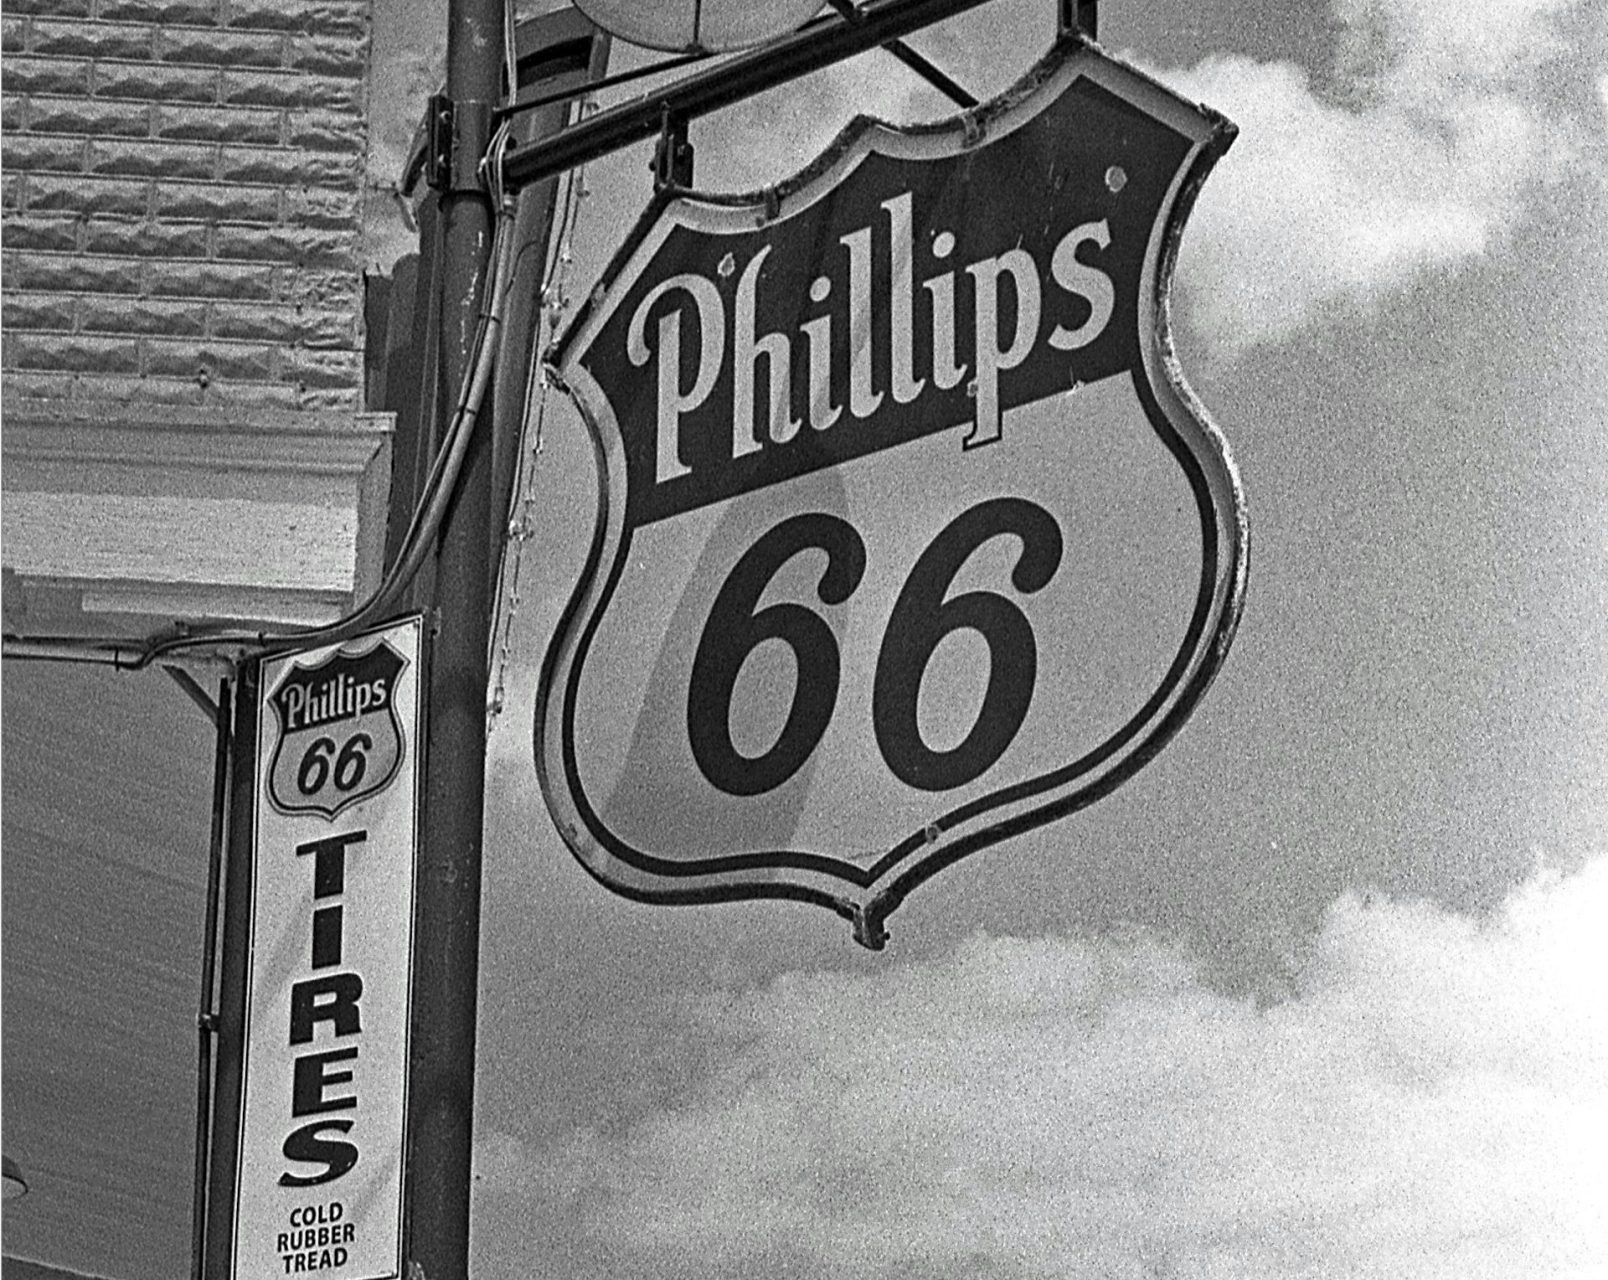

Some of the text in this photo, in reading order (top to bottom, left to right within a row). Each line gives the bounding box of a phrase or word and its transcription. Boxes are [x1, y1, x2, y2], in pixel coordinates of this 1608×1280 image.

[627, 191, 1116, 484] Phillips
[686, 497, 1064, 797] 66
[281, 673, 387, 728] Phillips
[297, 732, 373, 796] 66
[276, 829, 367, 1188] TIRES
[277, 1222, 355, 1252] RUBBER
[290, 1202, 343, 1227] COLD
[282, 1247, 348, 1274] TREAD
